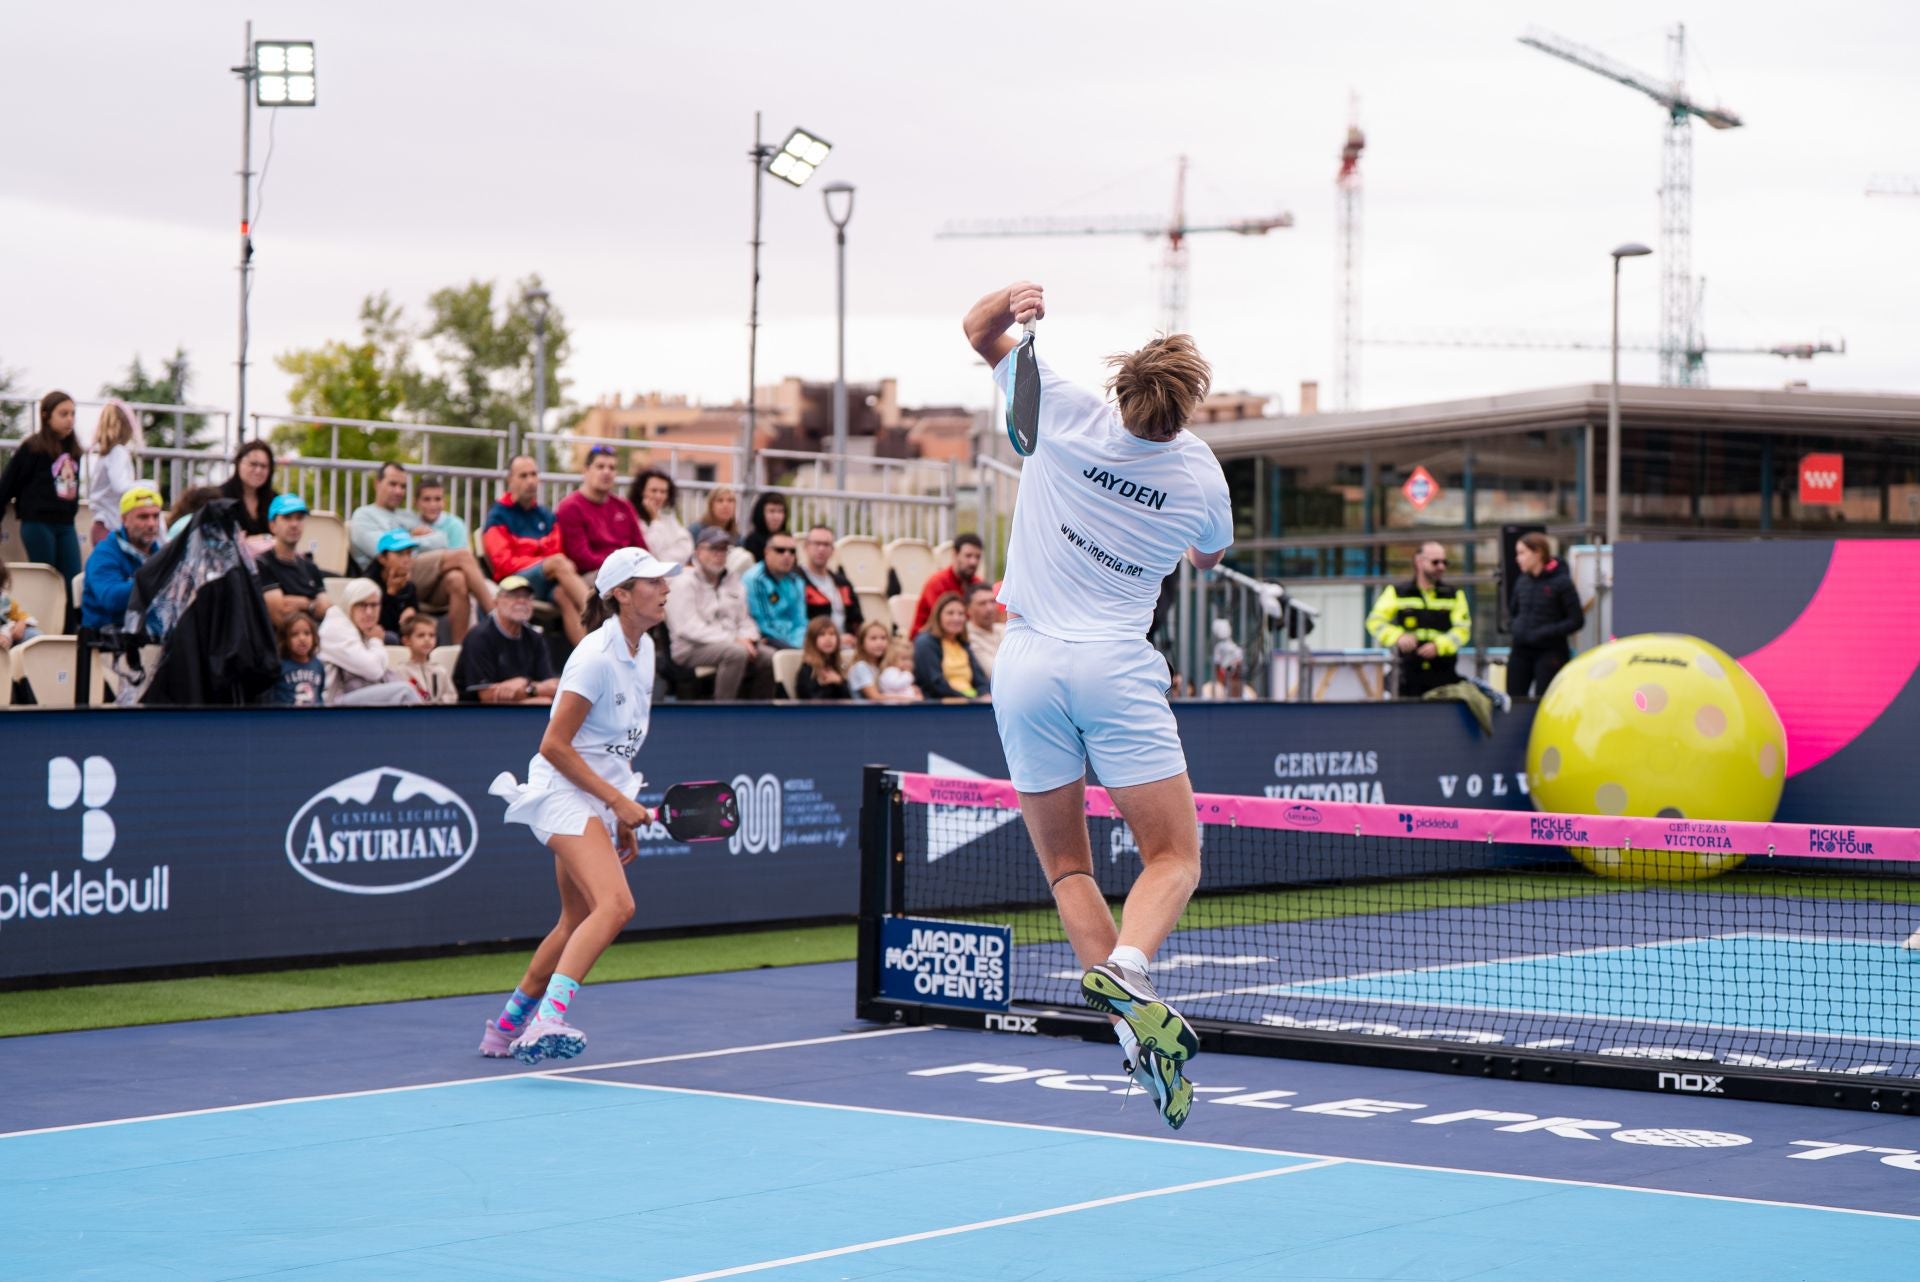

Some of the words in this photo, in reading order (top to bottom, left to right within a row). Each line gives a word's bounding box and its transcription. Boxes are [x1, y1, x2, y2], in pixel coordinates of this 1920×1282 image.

[1083, 467, 1167, 510] JAYDEN
[1060, 523, 1143, 577] www.inerzia.net
[1274, 750, 1379, 778] CERVEZAS
[930, 788, 983, 802] VICTORIA
[332, 811, 393, 825] CENTRAL
[400, 807, 459, 823] LECHERA
[1415, 818, 1459, 831] picklebull
[1531, 817, 1573, 831] PICKLE
[1669, 822, 1728, 834] CERVEZAS
[1809, 828, 1856, 842] PICKLE
[301, 815, 464, 864] ASTURIANA
[1663, 834, 1733, 849] VICTORIA
[911, 927, 1005, 958] MADRID
[914, 972, 977, 999] OPEN
